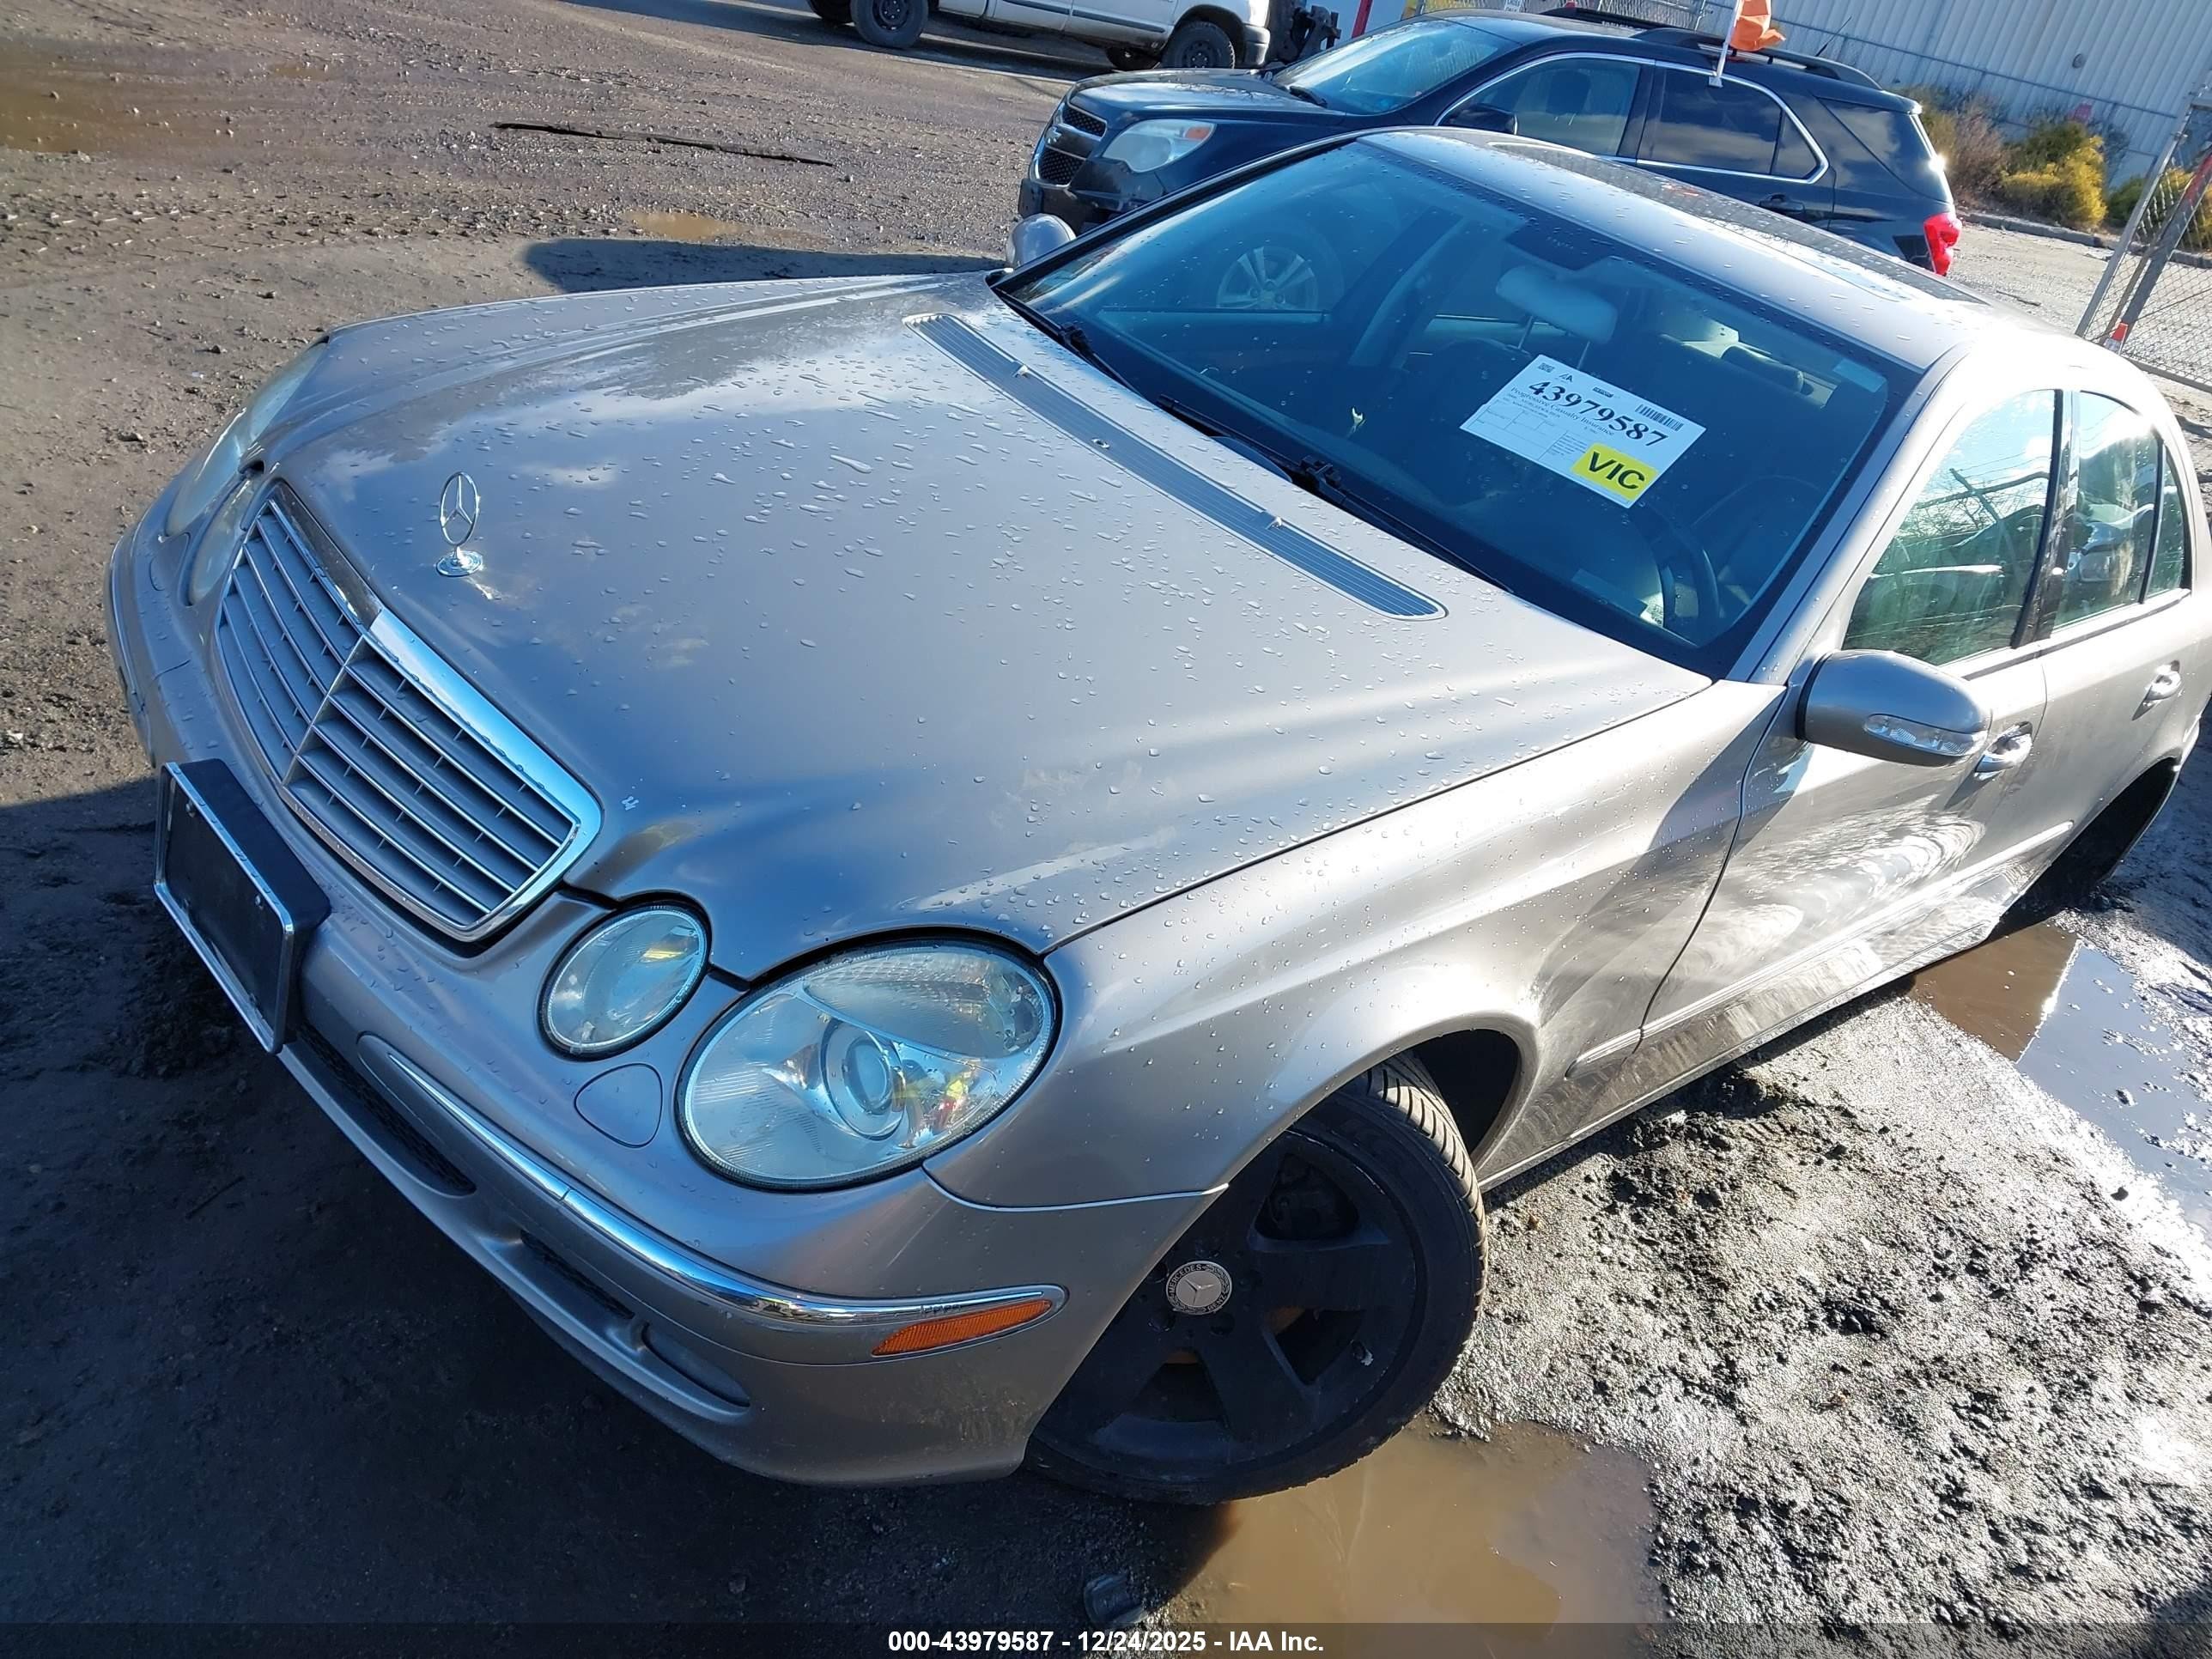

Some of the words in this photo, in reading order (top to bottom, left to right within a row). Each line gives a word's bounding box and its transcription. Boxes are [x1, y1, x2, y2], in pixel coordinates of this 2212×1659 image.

[1510, 386, 1549, 408] Progressive
[1551, 404, 1579, 420] Casualty
[1581, 416, 1614, 436] Insurance
[1528, 381, 1668, 447] 43979587
[1588, 451, 1645, 490] VIC
[1168, 1264, 1202, 1294] MERCEDES
[1206, 1294, 1227, 1312] BENZ
